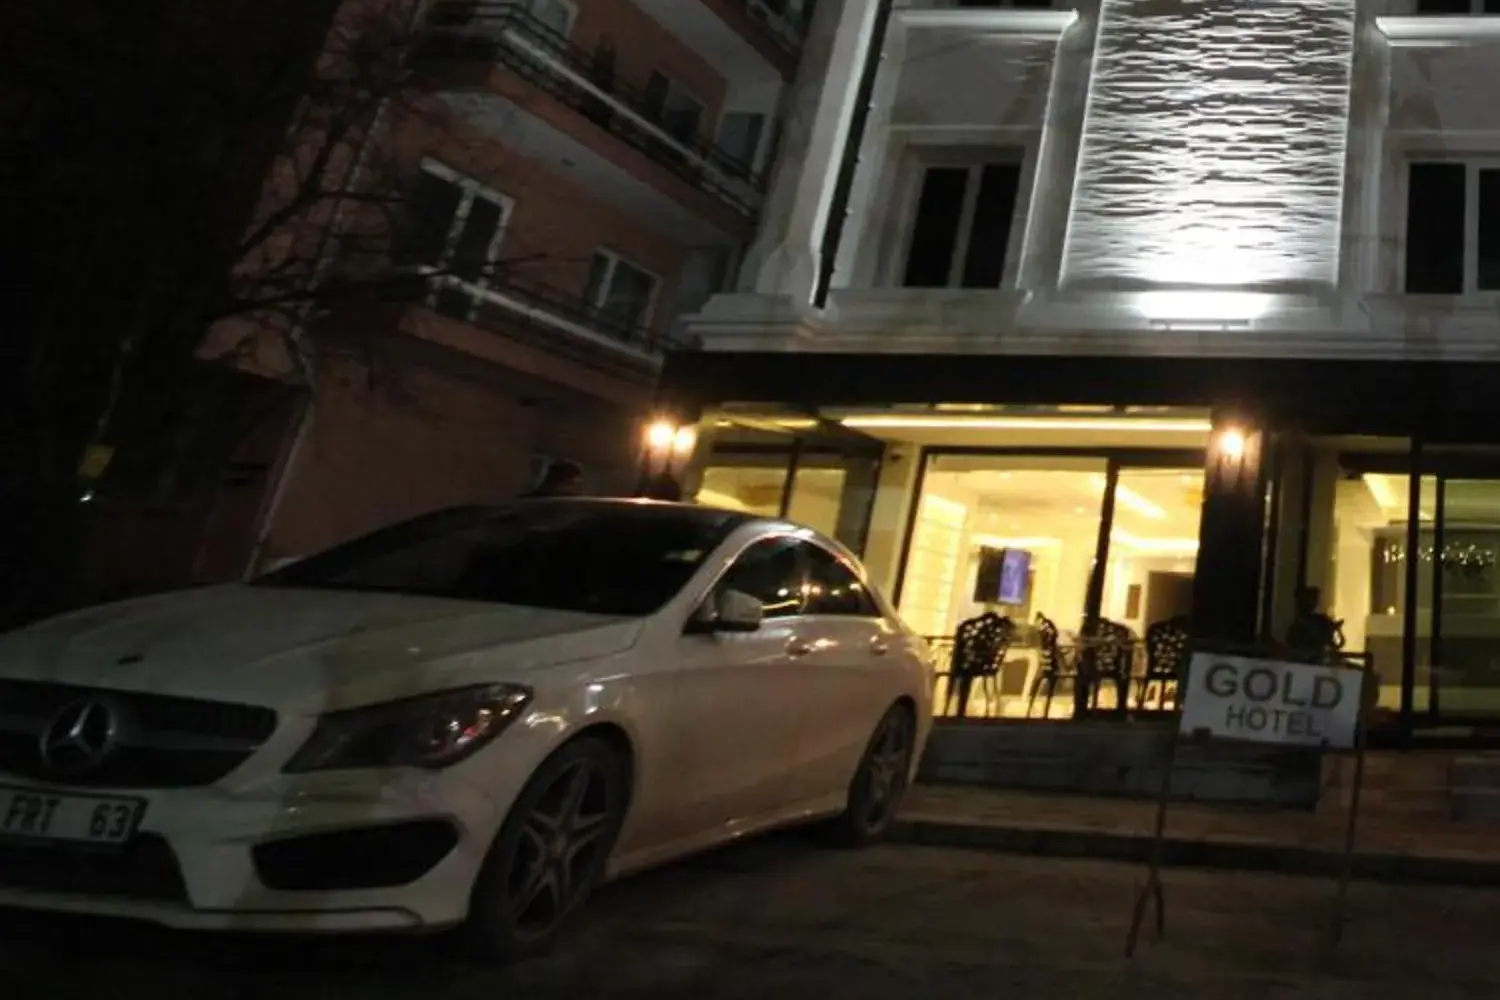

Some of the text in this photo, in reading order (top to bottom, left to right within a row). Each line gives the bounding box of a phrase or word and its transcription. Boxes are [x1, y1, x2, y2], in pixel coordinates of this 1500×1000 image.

[1205, 663, 1343, 711] GOLD
[1225, 704, 1322, 738] HOTEL
[90, 803, 131, 838] 63
